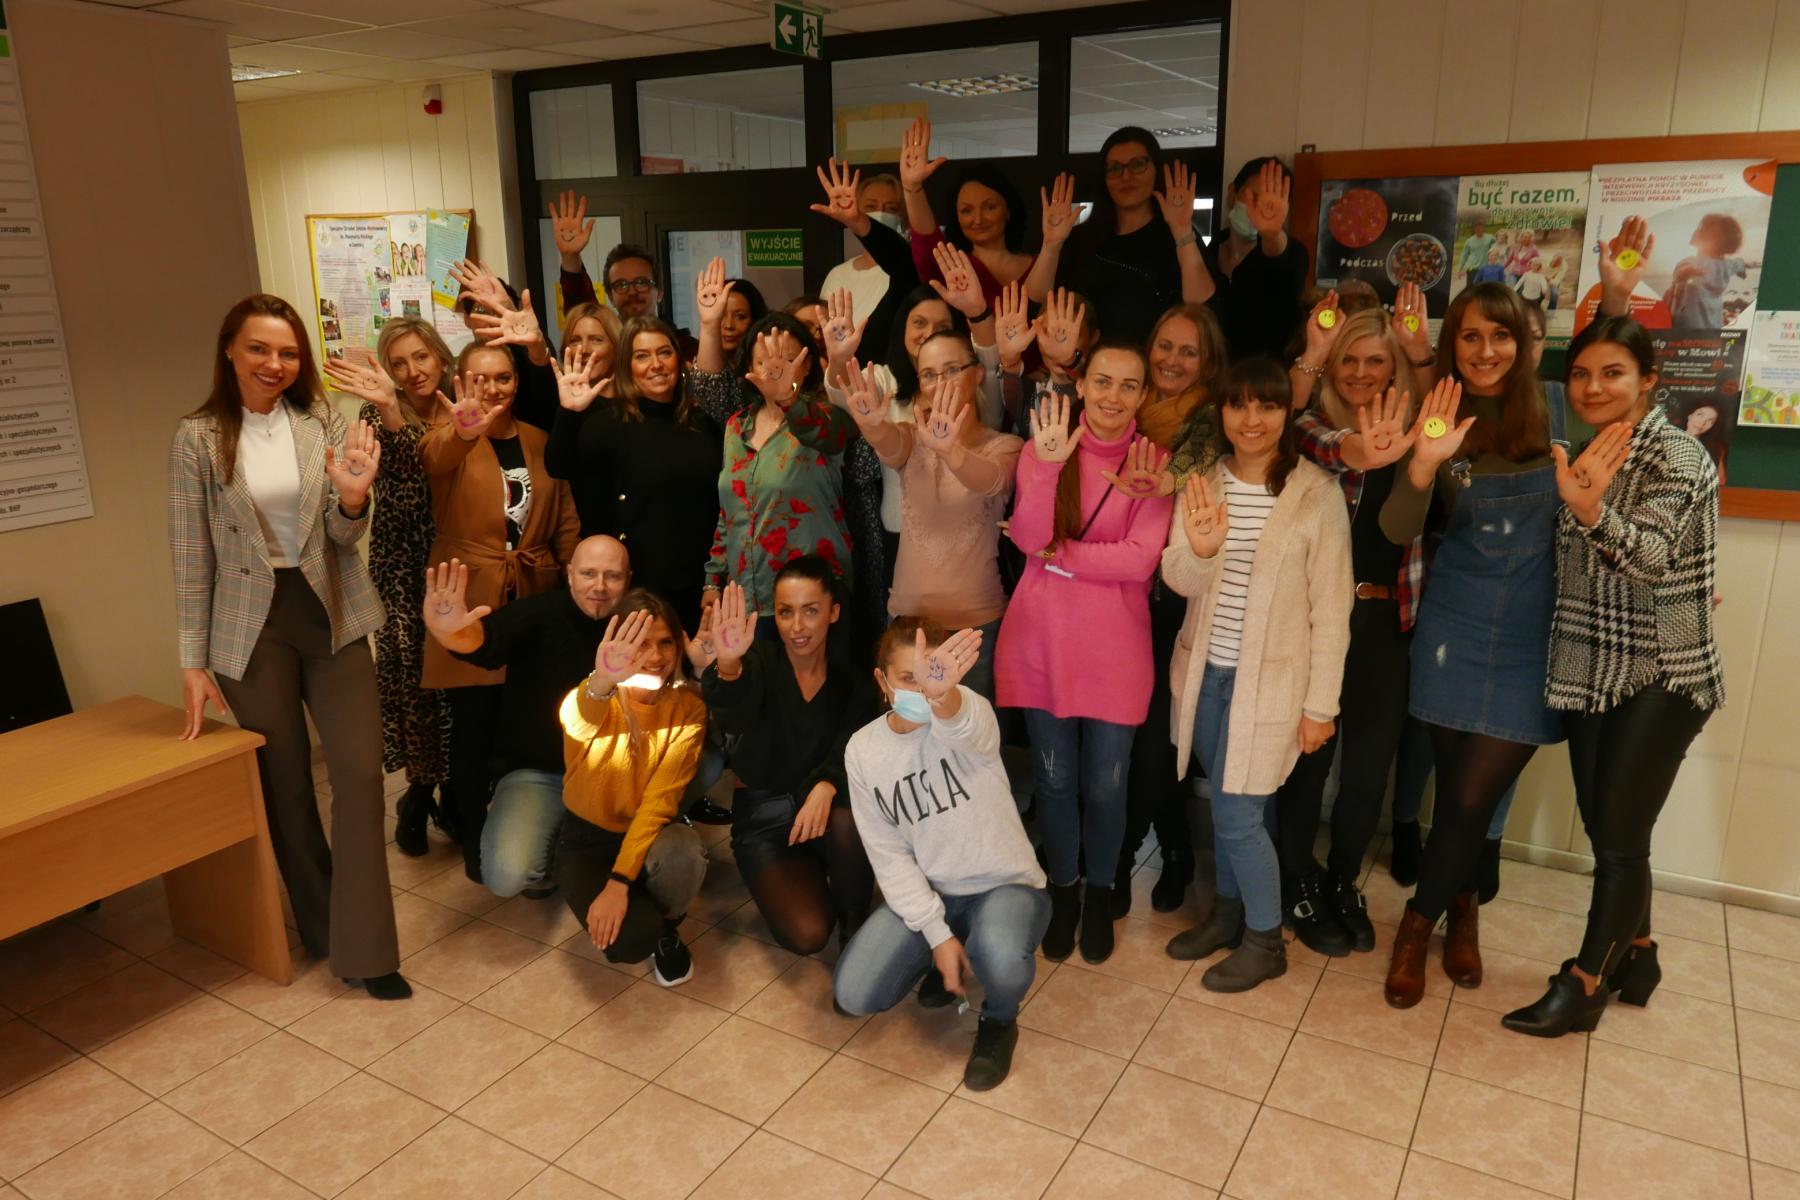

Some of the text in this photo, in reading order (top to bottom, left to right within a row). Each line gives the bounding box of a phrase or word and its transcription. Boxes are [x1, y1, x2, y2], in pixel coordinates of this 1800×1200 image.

[1468, 187, 1580, 210] być razem,
[1391, 210, 1423, 222] Przed
[750, 234, 801, 249] WYJŚCIE
[748, 252, 804, 261] EWAKUACYJNE
[1340, 257, 1385, 268] Podczas
